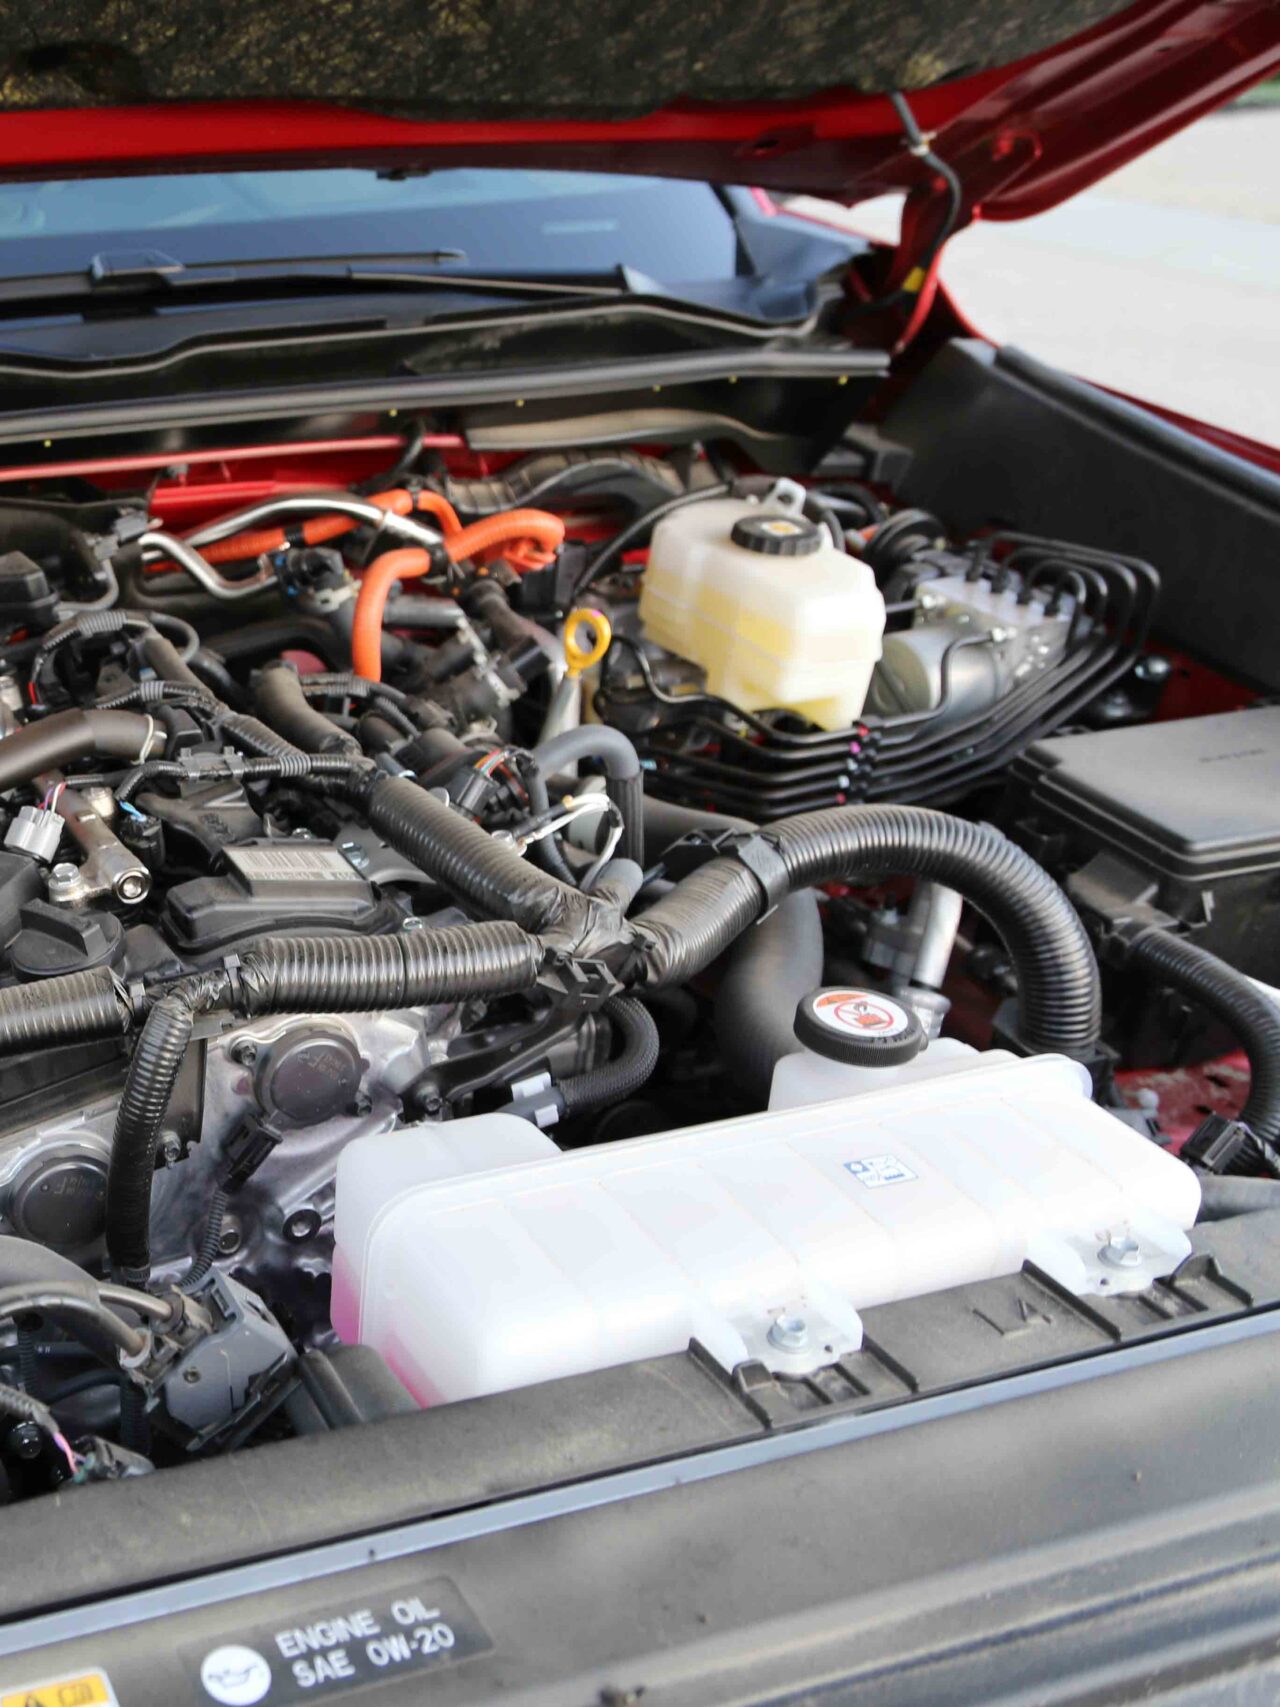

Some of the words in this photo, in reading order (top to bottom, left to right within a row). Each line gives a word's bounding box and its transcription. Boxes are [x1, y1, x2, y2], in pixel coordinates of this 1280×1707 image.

[274, 1609, 382, 1659] ENGINE
[390, 1596, 441, 1626] OIL
[291, 1647, 356, 1688] SAE
[365, 1621, 456, 1667] 0W-20
